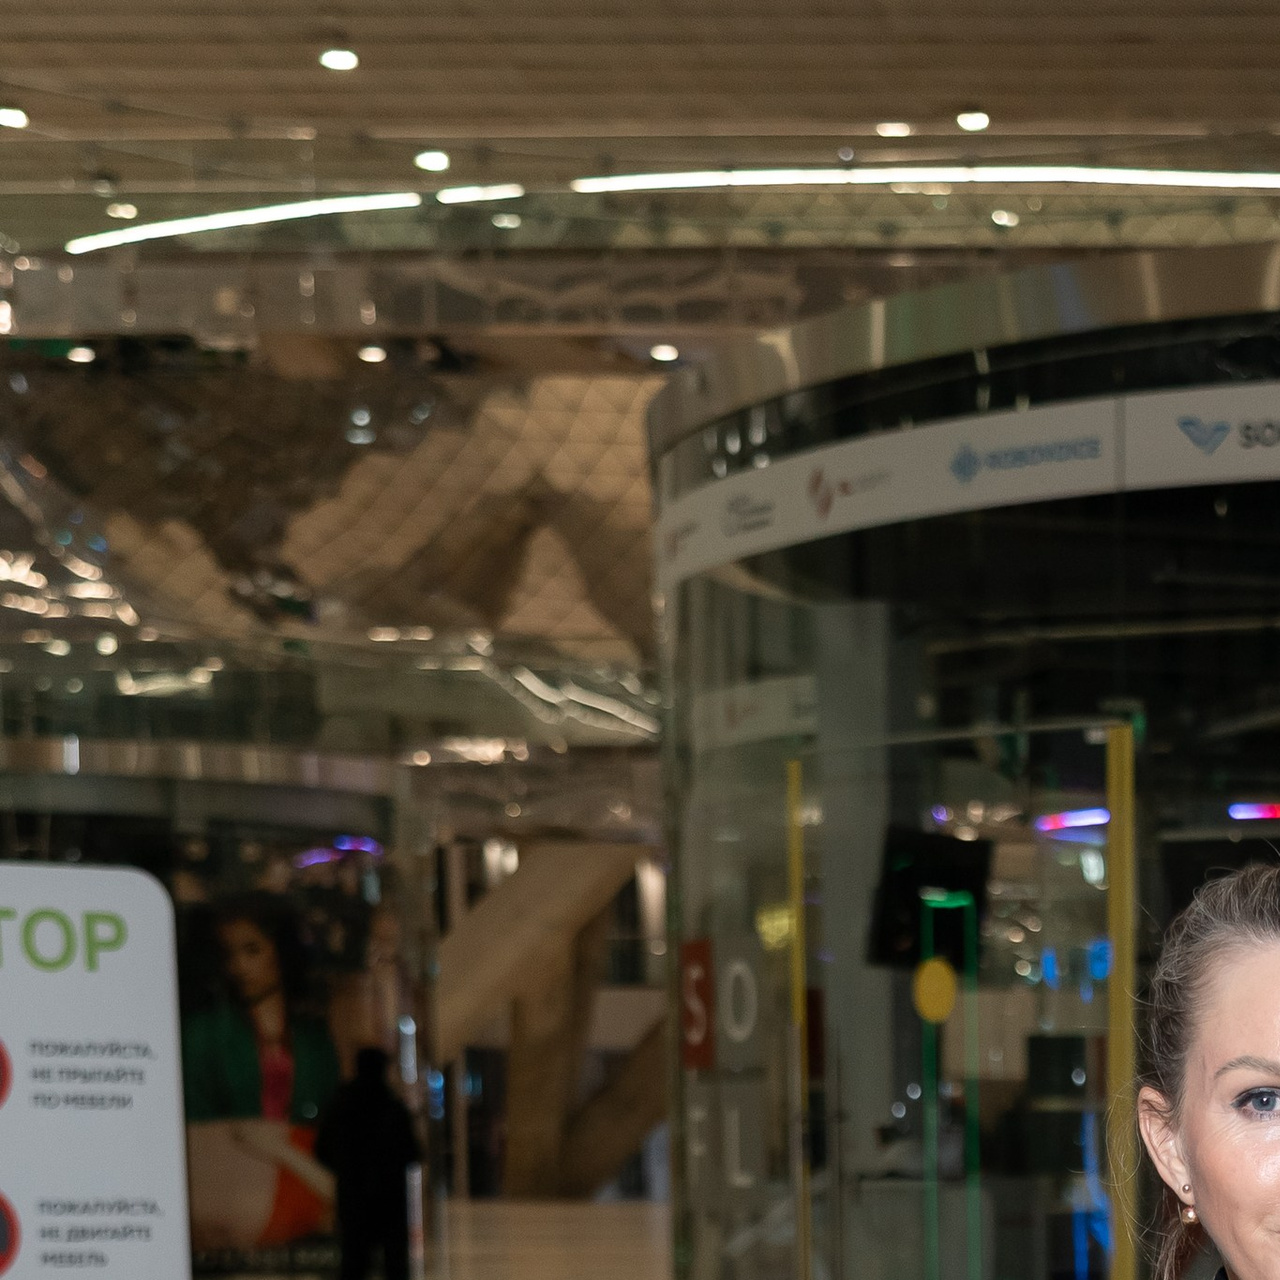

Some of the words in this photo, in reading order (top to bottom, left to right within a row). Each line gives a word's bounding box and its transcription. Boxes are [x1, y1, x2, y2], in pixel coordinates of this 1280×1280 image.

[32, 1067, 52, 1083] НЕ
[32, 1094, 61, 1110] ПО
[63, 1094, 133, 1111] МЕБЕЛИ
[40, 1225, 60, 1240] НЕ
[41, 1251, 109, 1268] МЕБЕЛЬ
